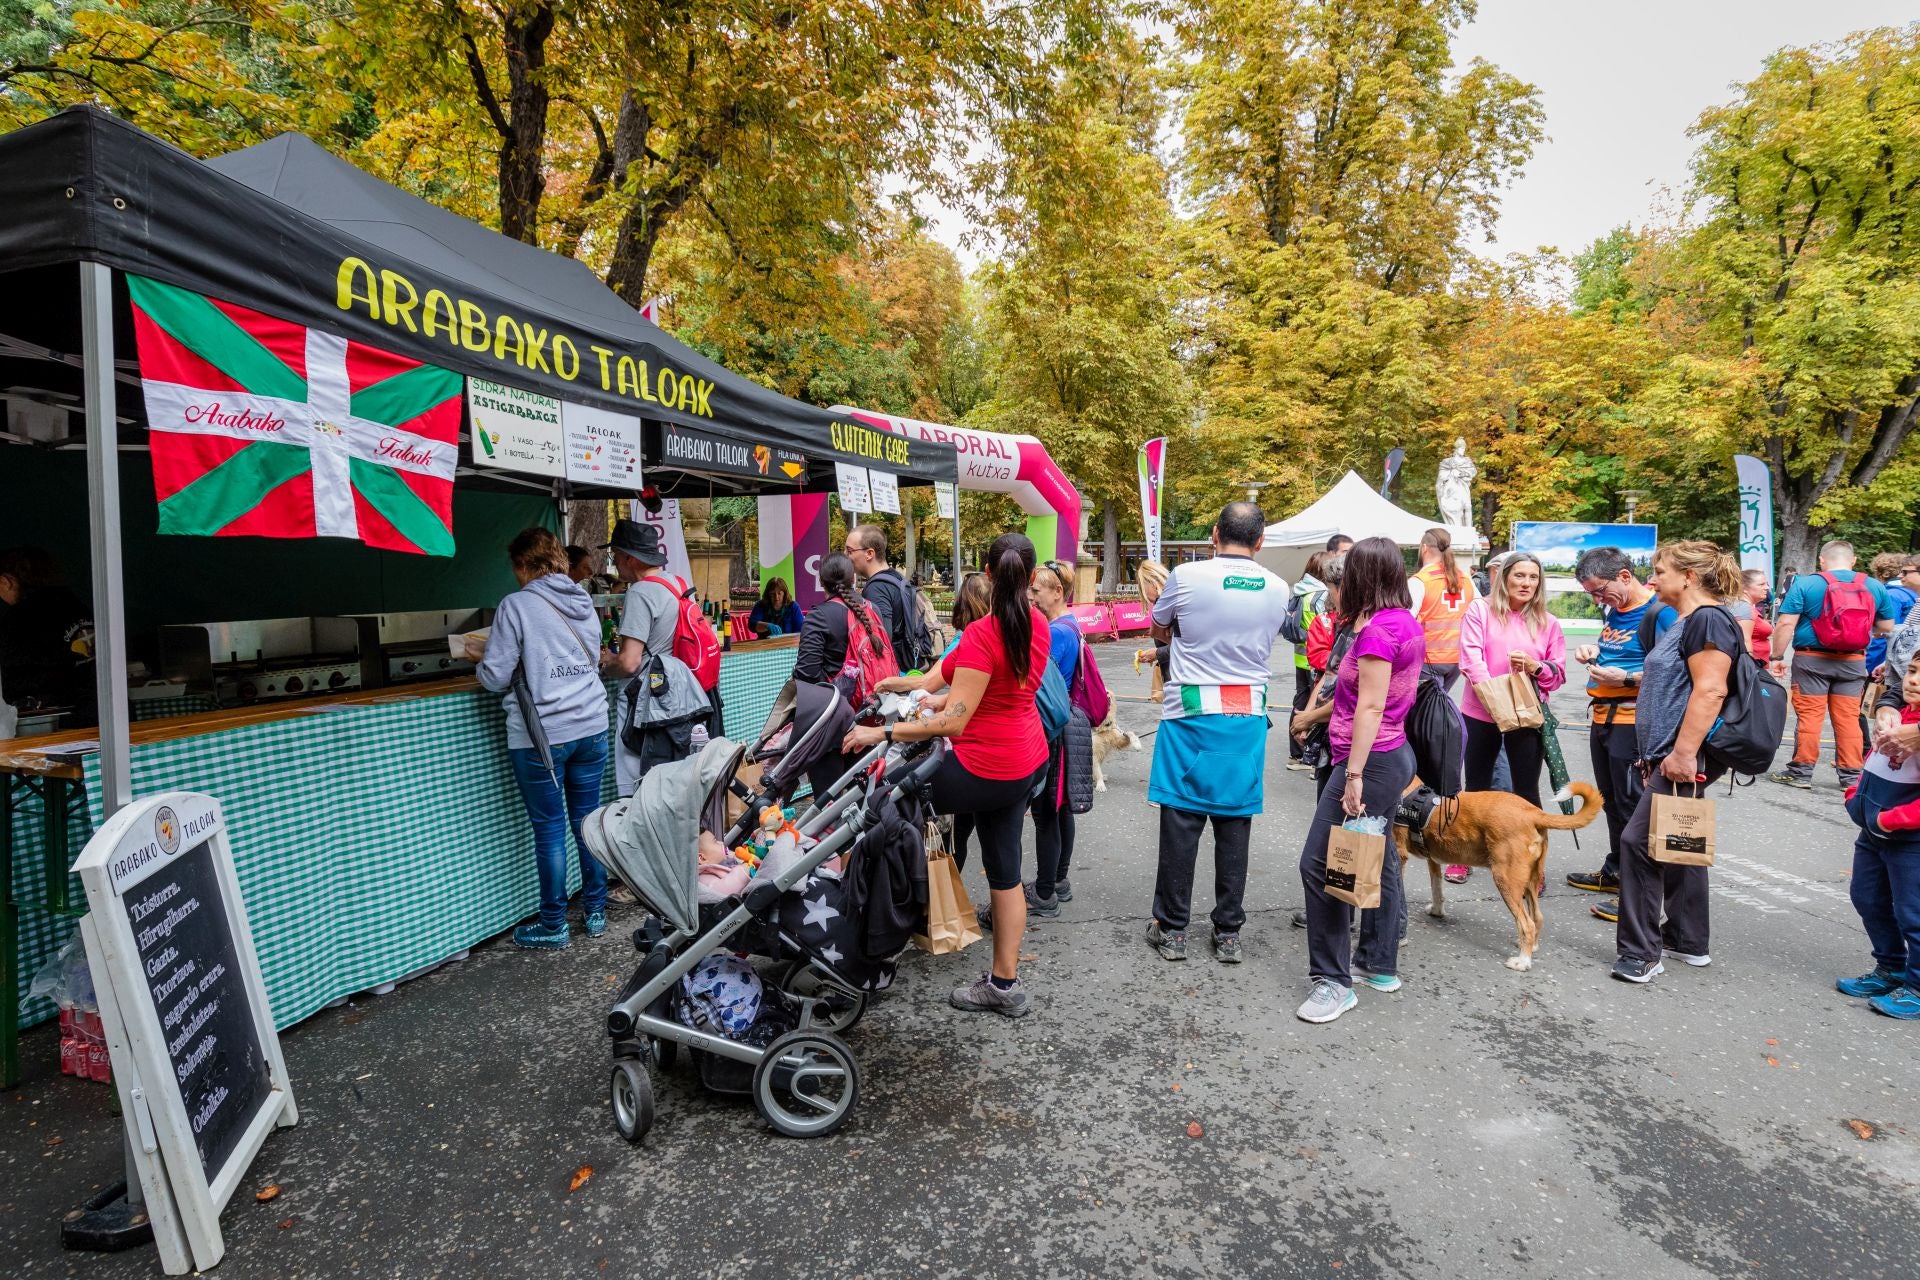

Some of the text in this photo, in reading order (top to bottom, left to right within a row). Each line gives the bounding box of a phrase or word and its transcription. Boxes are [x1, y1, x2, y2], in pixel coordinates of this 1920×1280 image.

[336, 257, 714, 418] ARABAKO TALOAK
[473, 379, 557, 409] SIDRA NATURAL
[185, 402, 433, 466] Arabako Taloak
[517, 437, 534, 446] VASO
[586, 425, 622, 440] TALOAK
[830, 421, 910, 466] GLUTENIK GABE
[509, 450, 535, 461] BOTELLA
[666, 434, 749, 467] ARABAKO TALOAK
[966, 461, 1011, 480] kutxa
[114, 842, 158, 881] ARABAKO
[183, 810, 217, 839] TALOAK
[130, 882, 181, 923] Txistorra.
[138, 898, 200, 952] Hirugiharra.
[147, 946, 179, 978] Gazta.
